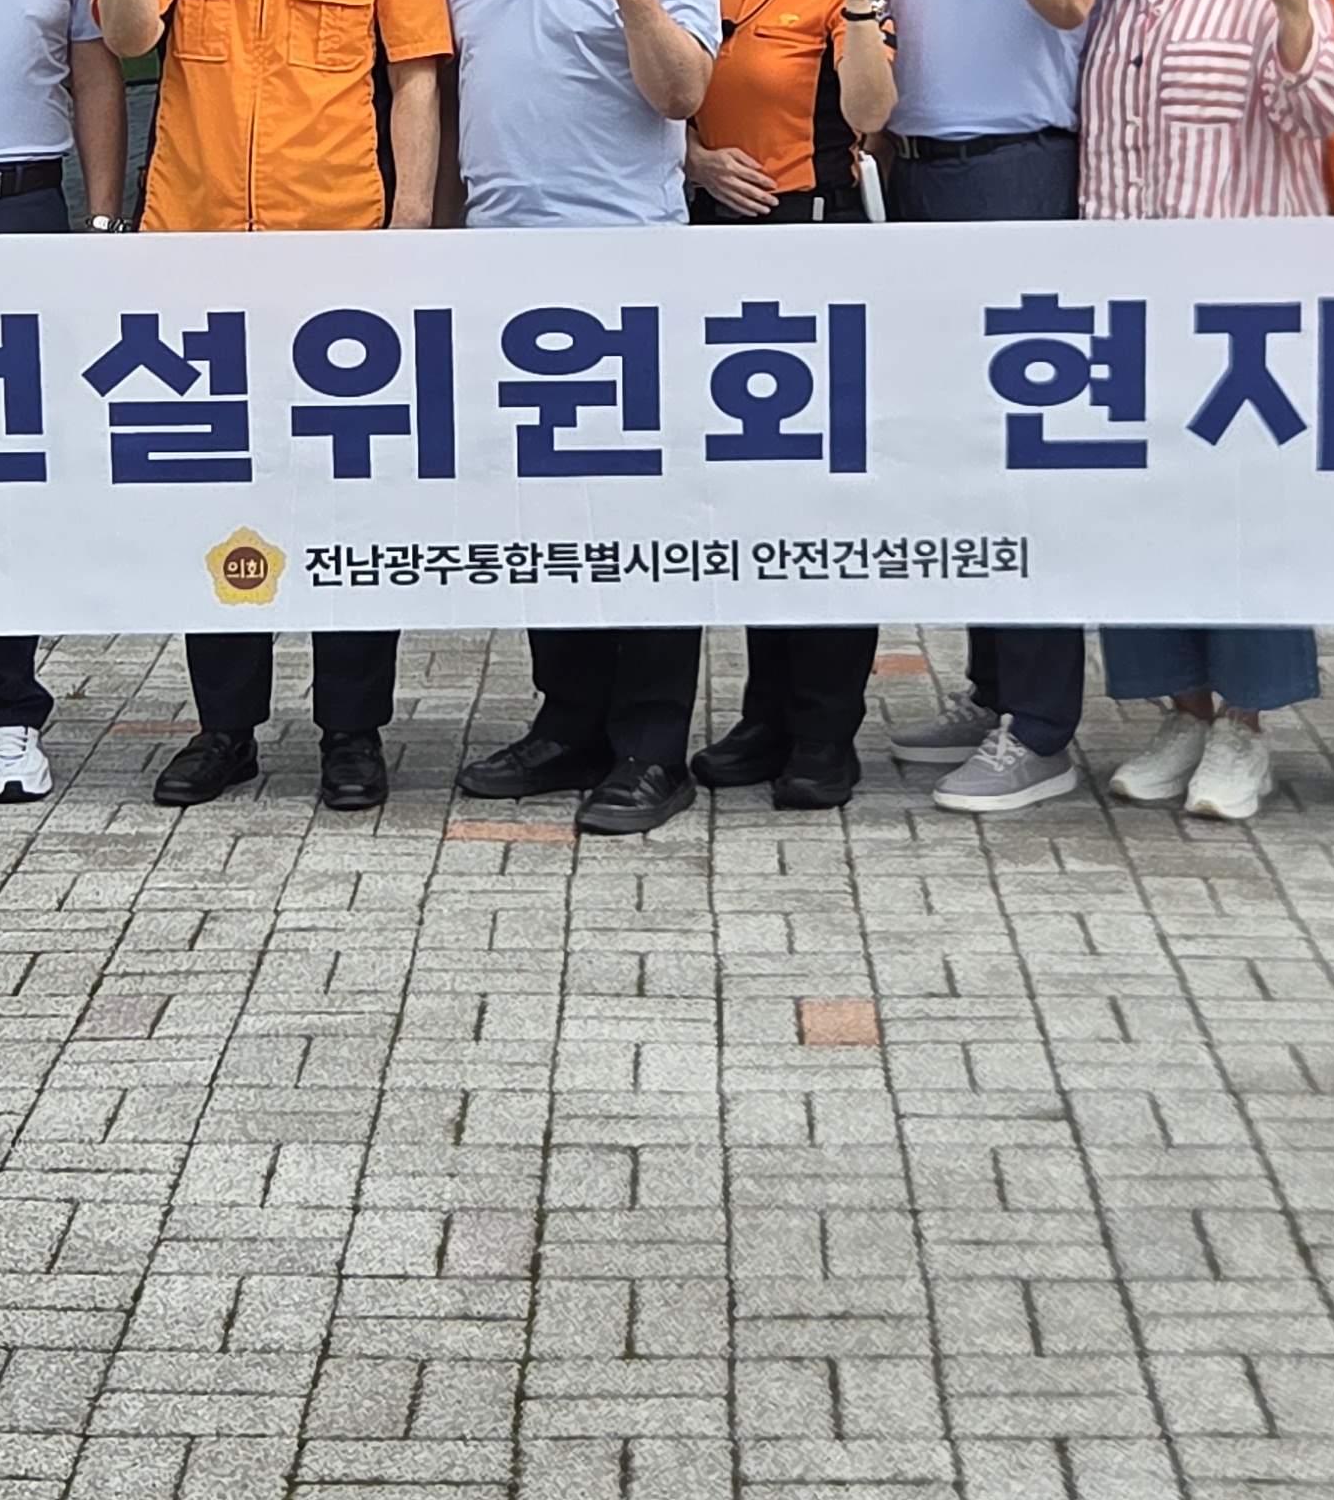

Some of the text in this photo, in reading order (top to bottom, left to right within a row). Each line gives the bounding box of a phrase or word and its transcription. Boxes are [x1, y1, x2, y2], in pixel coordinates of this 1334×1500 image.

[226, 558, 265, 579] 의회
[305, 536, 1029, 587] 전남광주통합특별시의회 안전건설위원회
